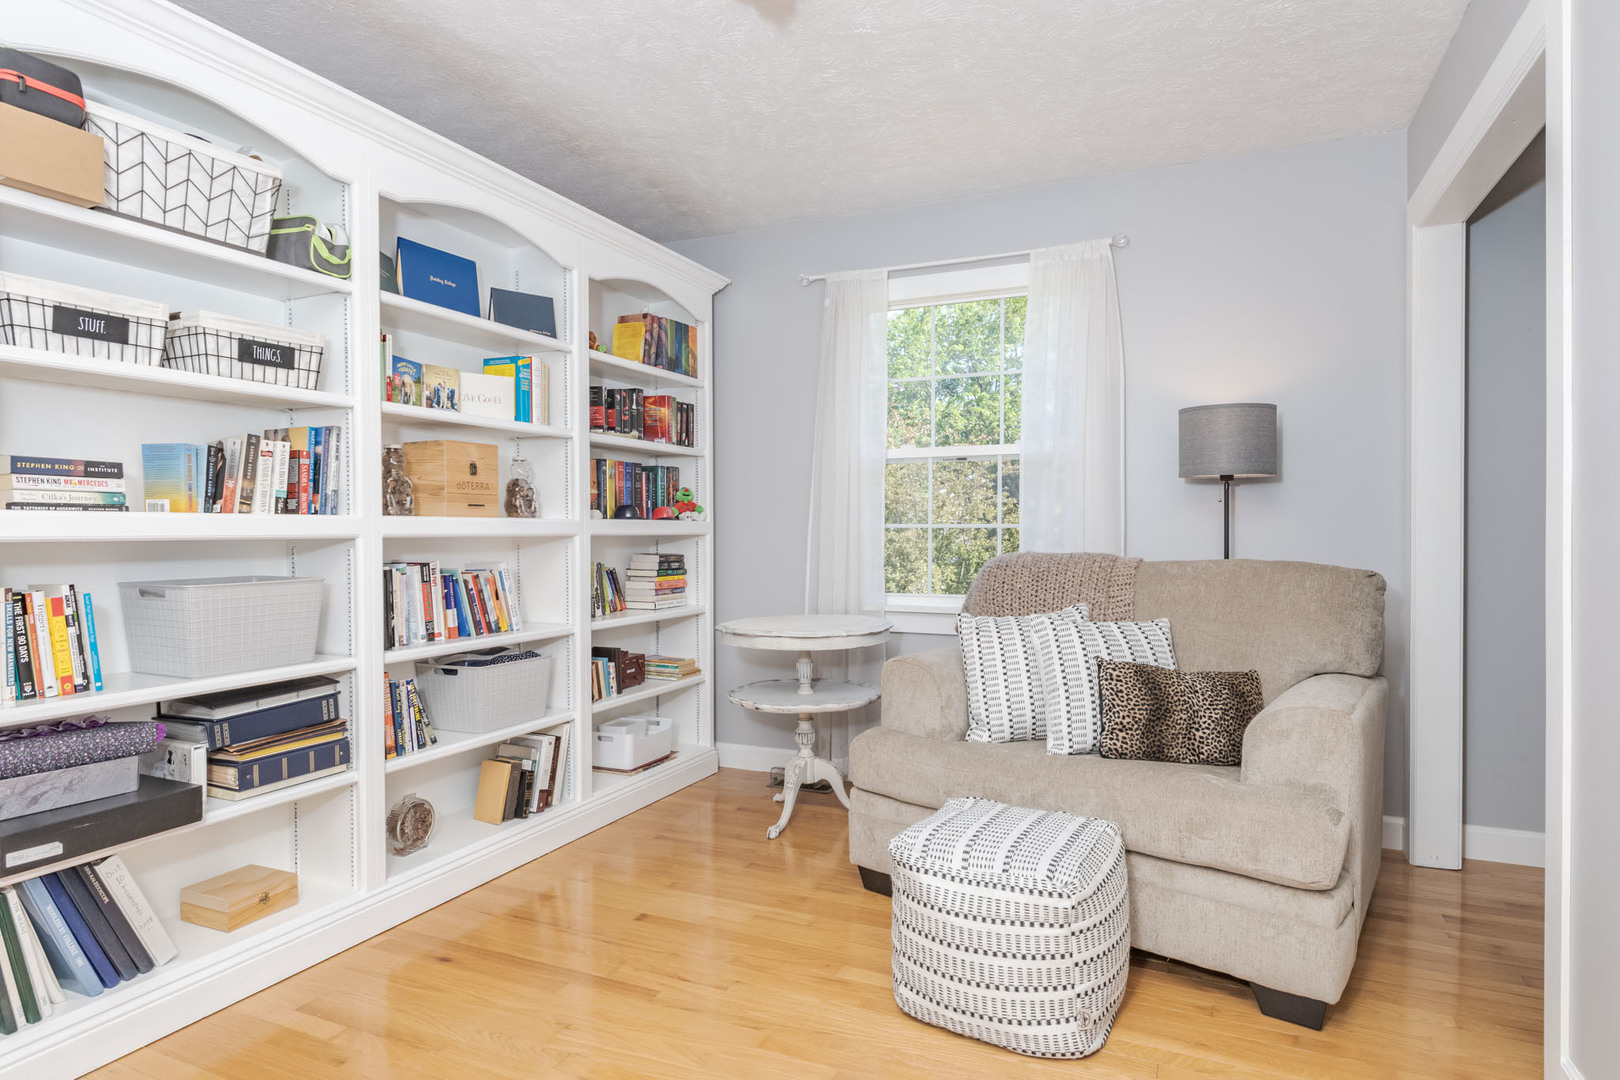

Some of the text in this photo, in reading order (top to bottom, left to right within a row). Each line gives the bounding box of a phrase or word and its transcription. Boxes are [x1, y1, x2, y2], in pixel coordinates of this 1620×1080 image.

[78, 317, 106, 334] STUFF.
[253, 345, 282, 363] THINGS.
[16, 476, 46, 484] STEPHEN
[78, 480, 108, 488] MERCEDES
[260, 458, 271, 513] SANDRA BROWN
[67, 494, 98, 503] Journey
[16, 616, 24, 634] FIRST
[18, 636, 26, 646] 90
[19, 647, 29, 663] DAYS
[63, 935, 78, 956] COLLEGE
